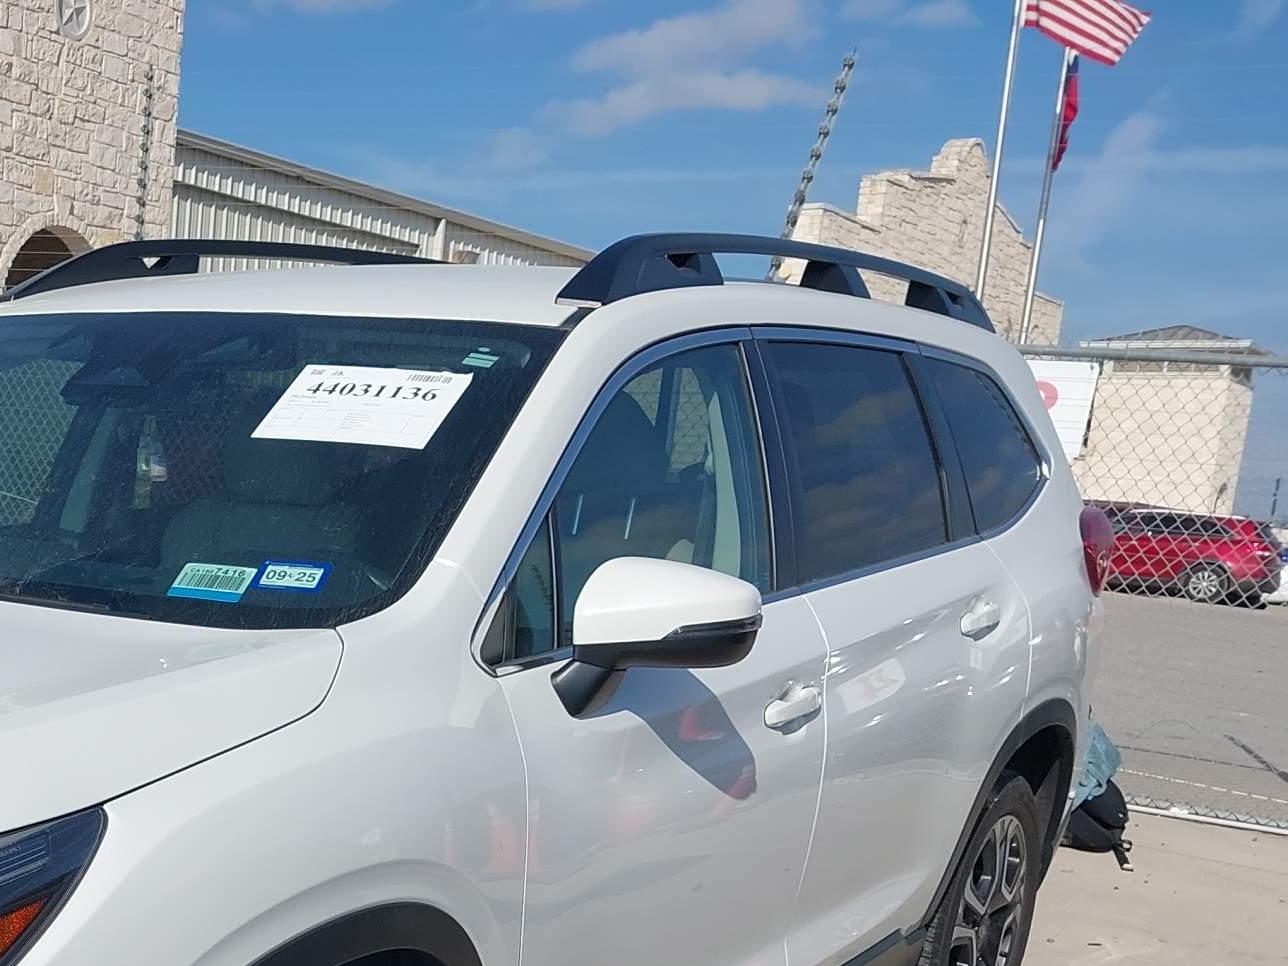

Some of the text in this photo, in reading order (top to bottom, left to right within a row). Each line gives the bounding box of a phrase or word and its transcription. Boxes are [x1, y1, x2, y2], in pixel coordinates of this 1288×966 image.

[305, 381, 441, 401] 44031136
[265, 569, 319, 583] 09 25
